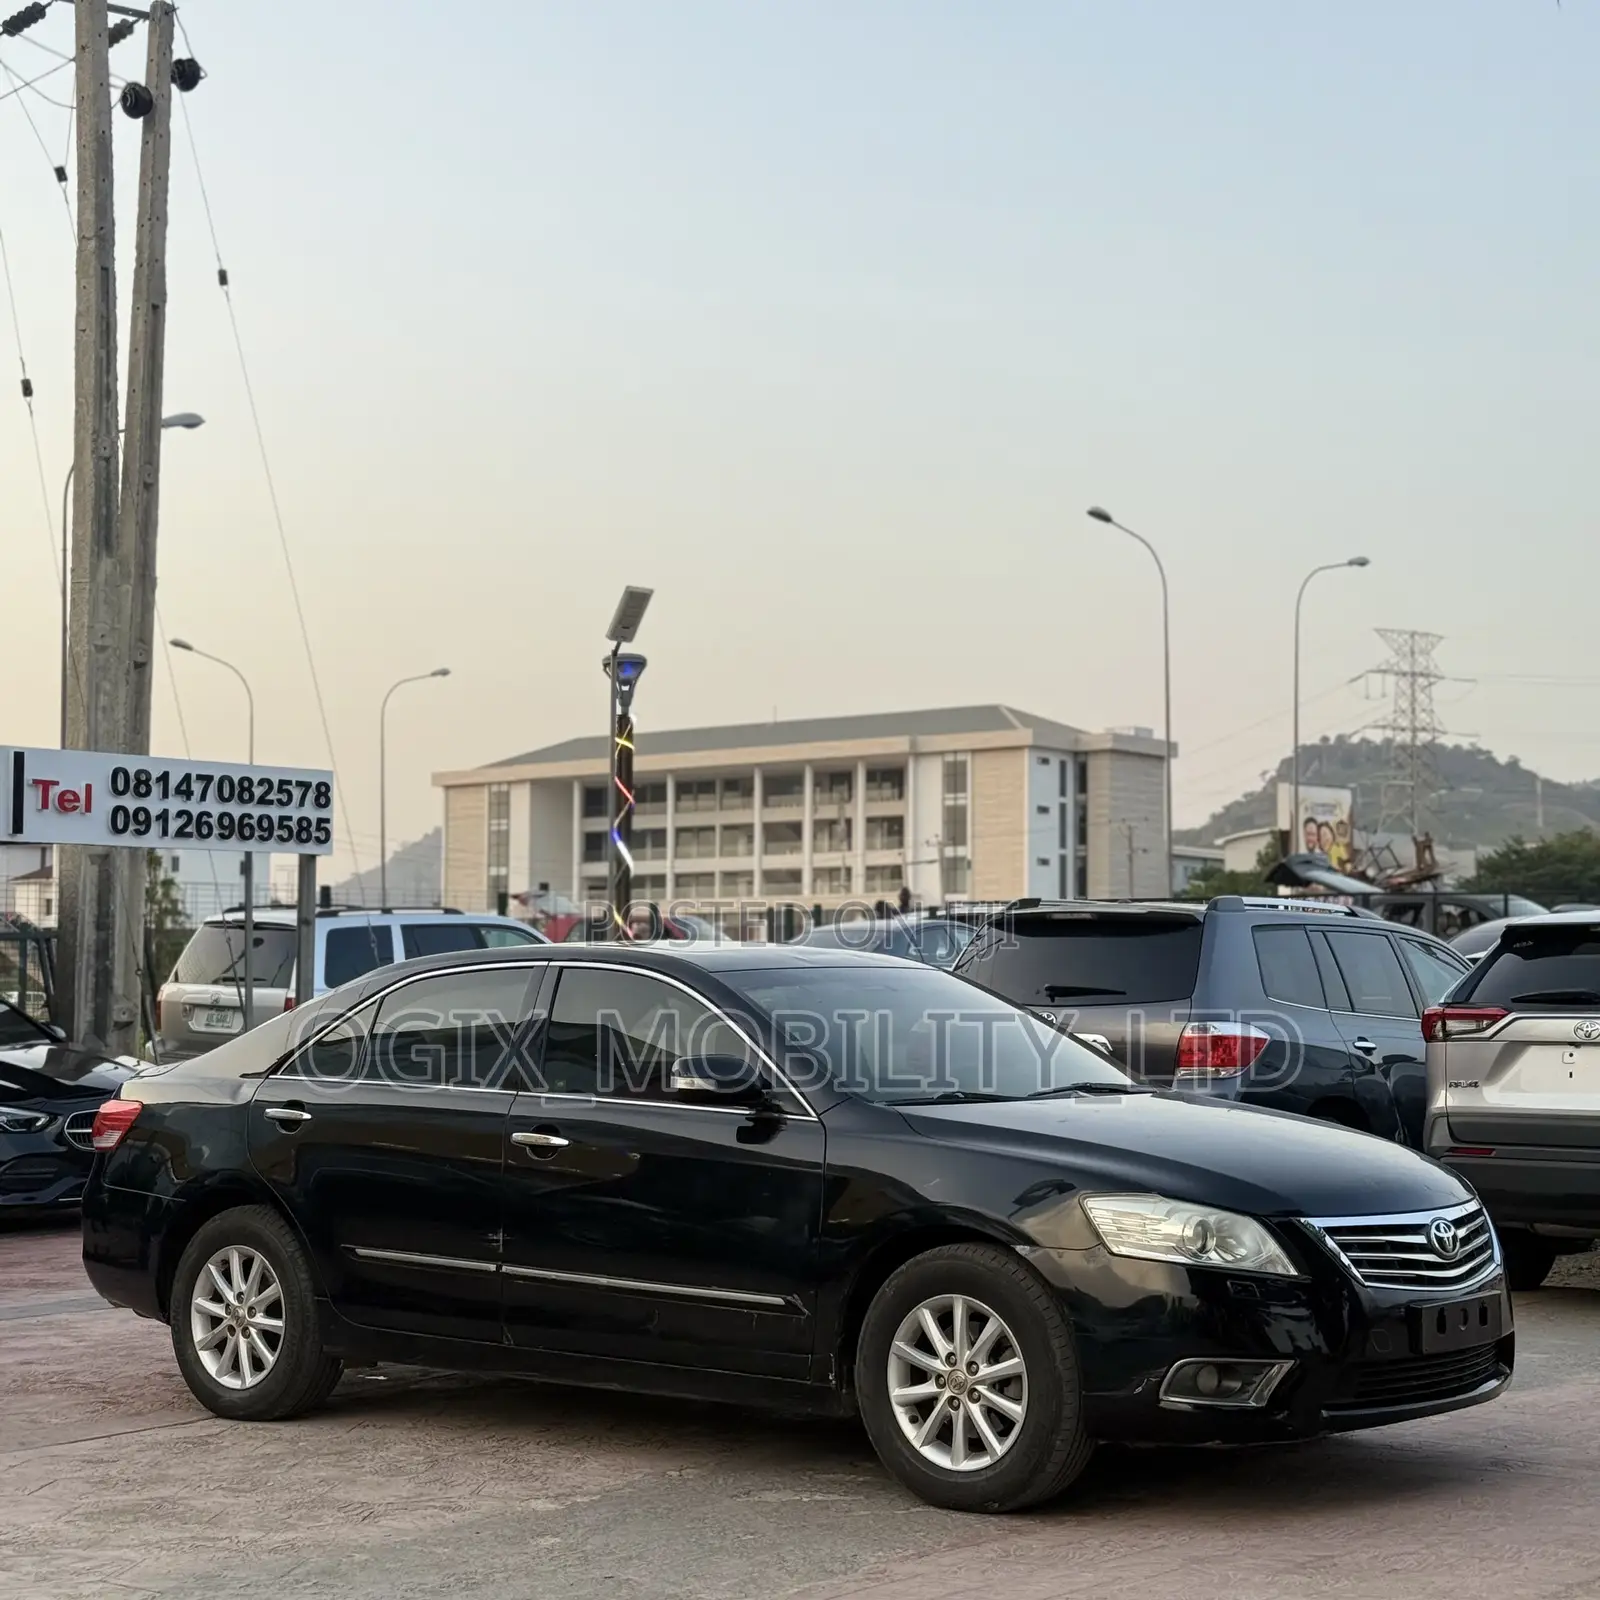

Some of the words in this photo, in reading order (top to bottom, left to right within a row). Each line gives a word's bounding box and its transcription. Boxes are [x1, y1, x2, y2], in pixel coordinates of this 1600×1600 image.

[29, 778, 93, 814] Tel
[109, 766, 332, 809] 08147082578
[109, 805, 332, 845] 09126969585
